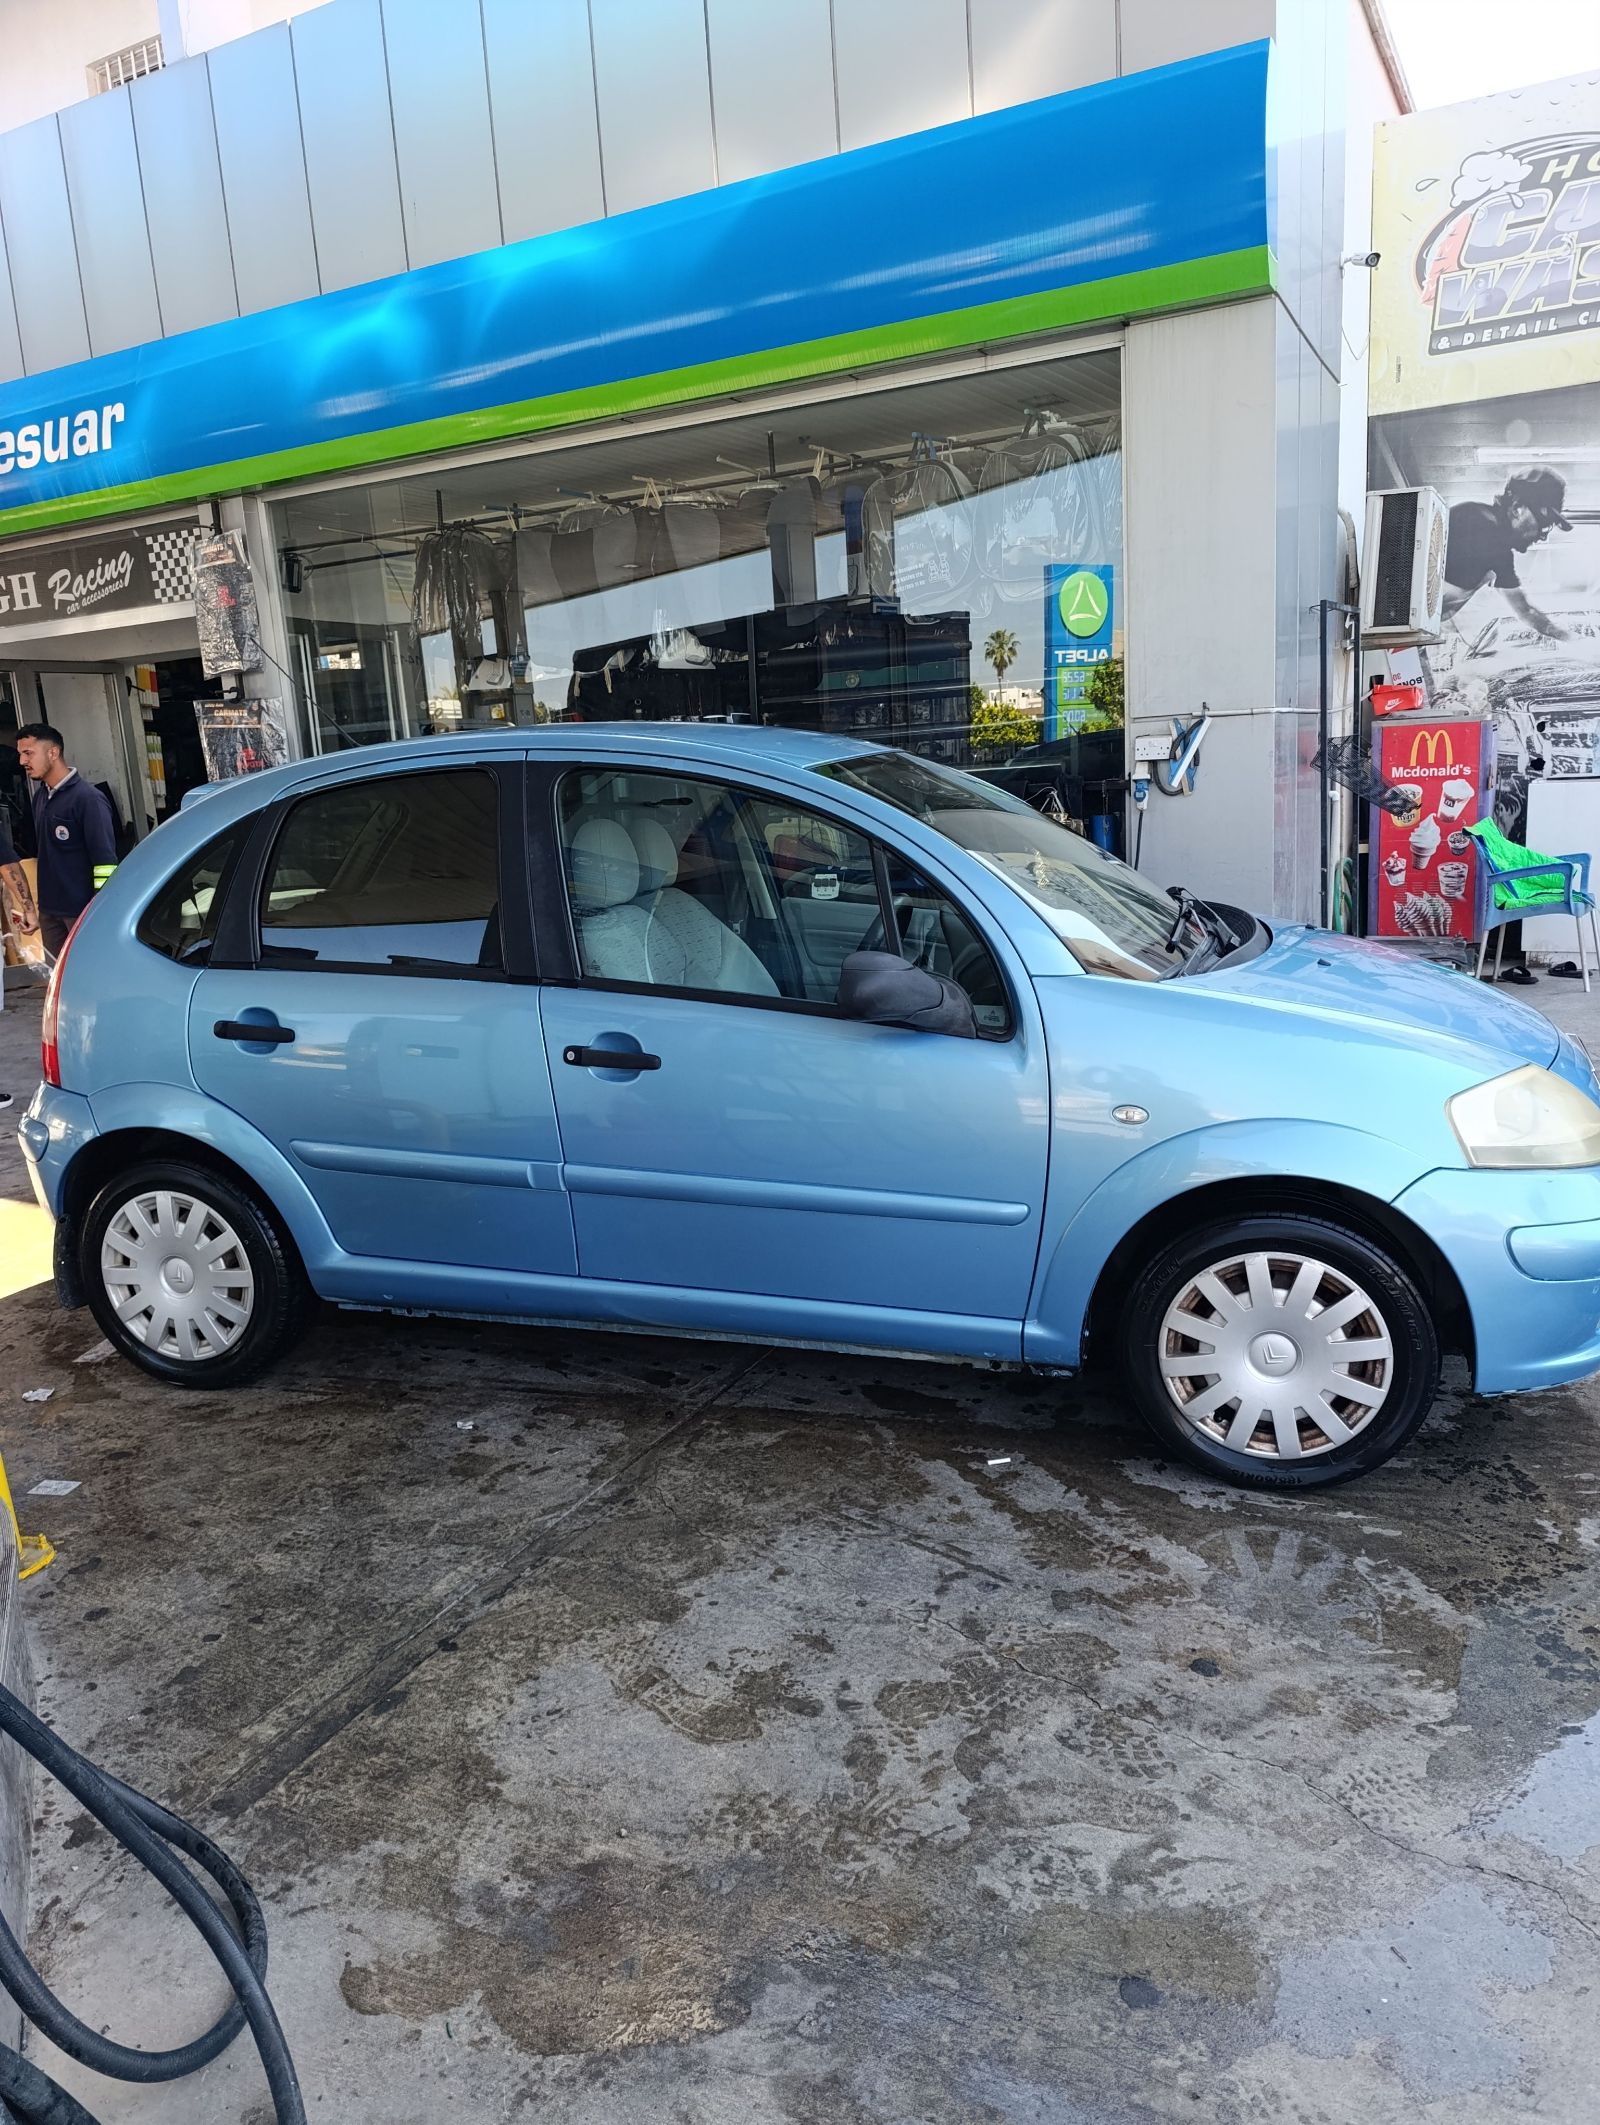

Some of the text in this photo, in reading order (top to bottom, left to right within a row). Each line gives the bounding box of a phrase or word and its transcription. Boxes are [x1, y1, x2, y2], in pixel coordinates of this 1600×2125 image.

[1437, 311, 1600, 350] & DETAIL C
[0, 402, 125, 475] esuar
[48, 550, 135, 611] Racing
[66, 578, 124, 615] car accessories
[1391, 763, 1472, 779] Mcdonald's
